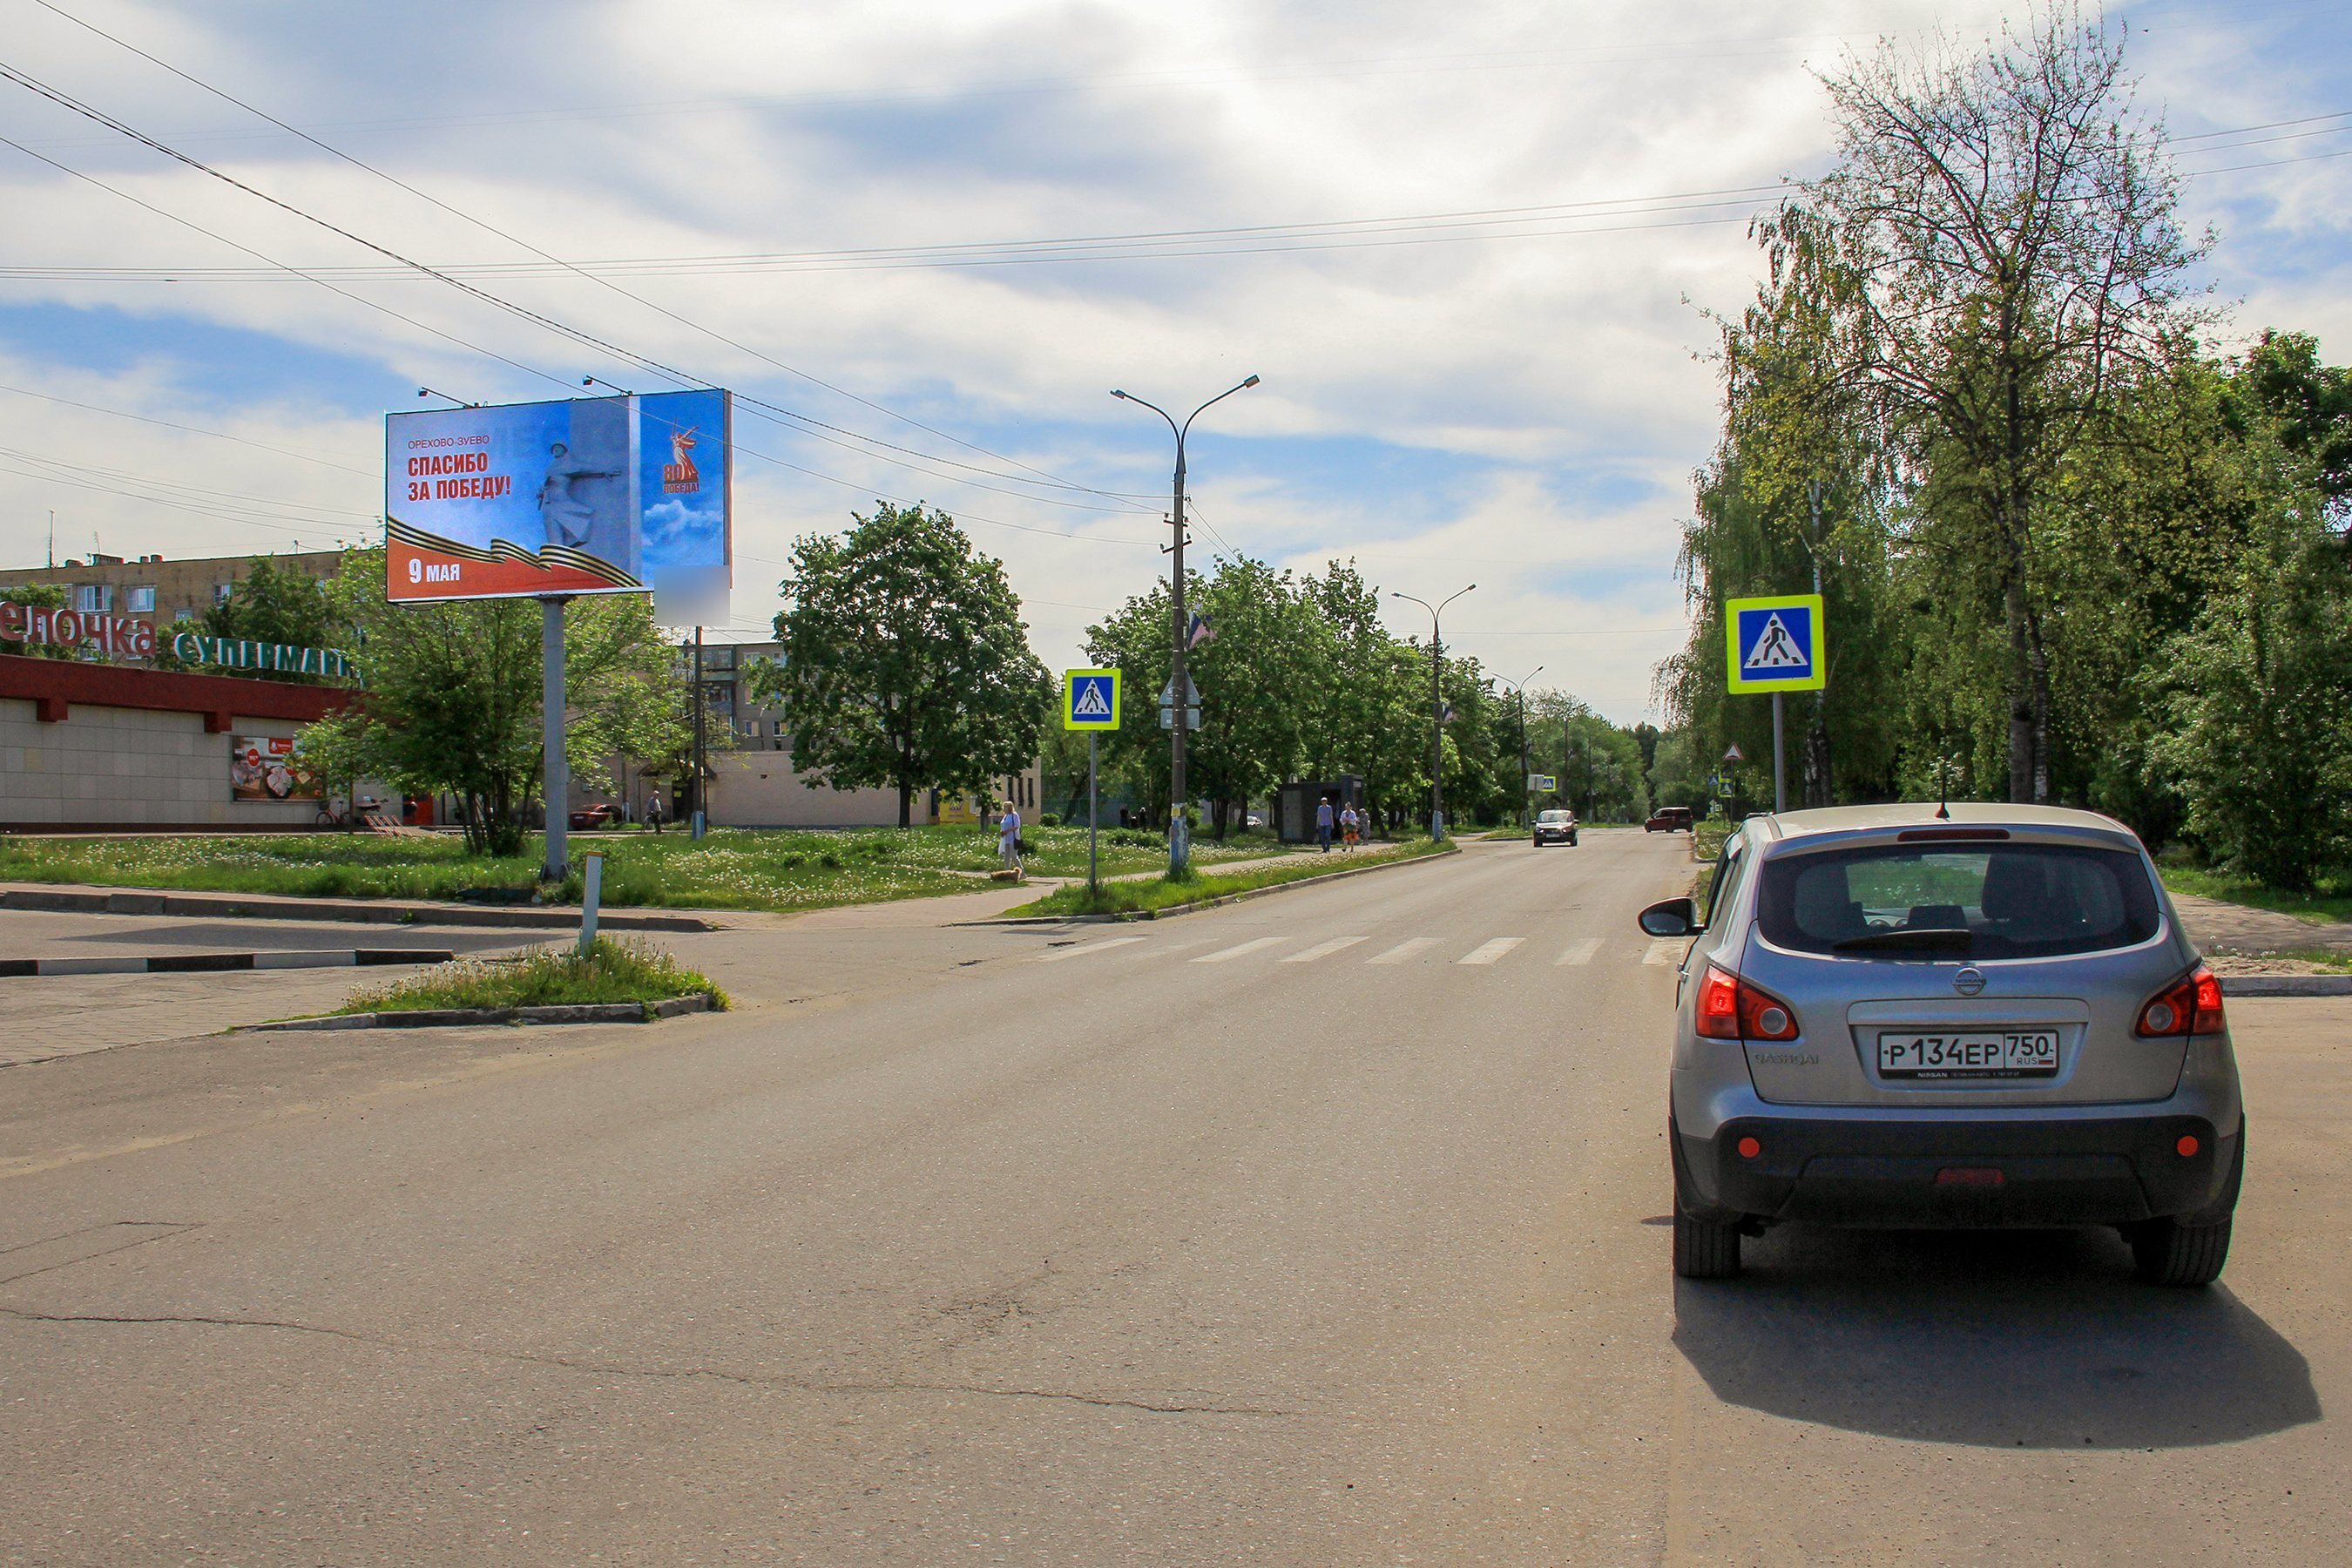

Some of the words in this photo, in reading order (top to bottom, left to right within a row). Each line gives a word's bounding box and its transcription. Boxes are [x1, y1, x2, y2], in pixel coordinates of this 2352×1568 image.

[408, 435, 490, 449] ОРЕХОВО-ЗУЕВО
[408, 452, 488, 477] СПАСИБО
[664, 463, 684, 482] 80
[408, 481, 430, 502] ЗА
[436, 476, 510, 500] ПОБЕДУ!
[664, 483, 700, 494] ПОБЕДА!
[409, 558, 422, 584] 9
[426, 564, 460, 583] МАЯ
[1889, 1037, 1999, 1065] Р134ЕР
[2006, 1035, 2049, 1057] 750
[2016, 1057, 2038, 1065] RUS
